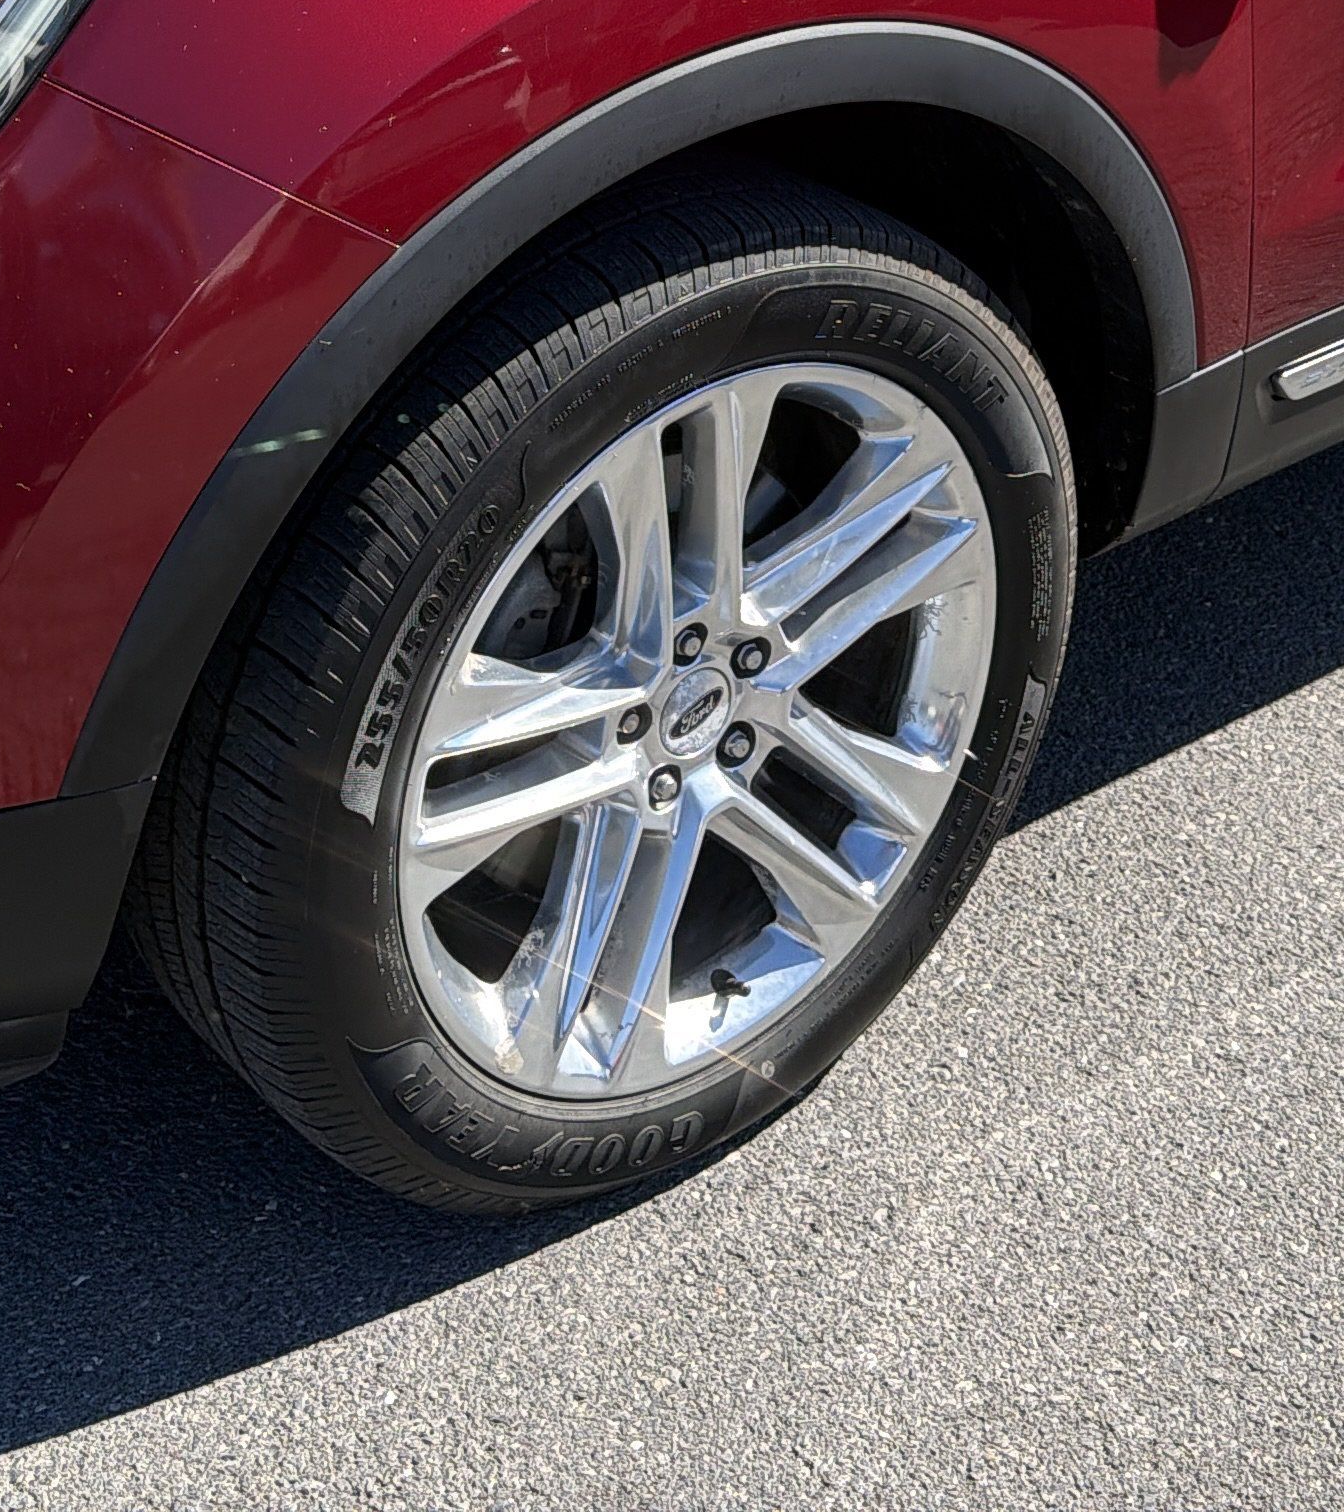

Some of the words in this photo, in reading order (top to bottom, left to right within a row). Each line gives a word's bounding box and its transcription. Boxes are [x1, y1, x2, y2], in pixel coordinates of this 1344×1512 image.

[815, 299, 1009, 413] RELIANT
[356, 503, 500, 770] 255/50R20
[680, 694, 714, 734] Ford
